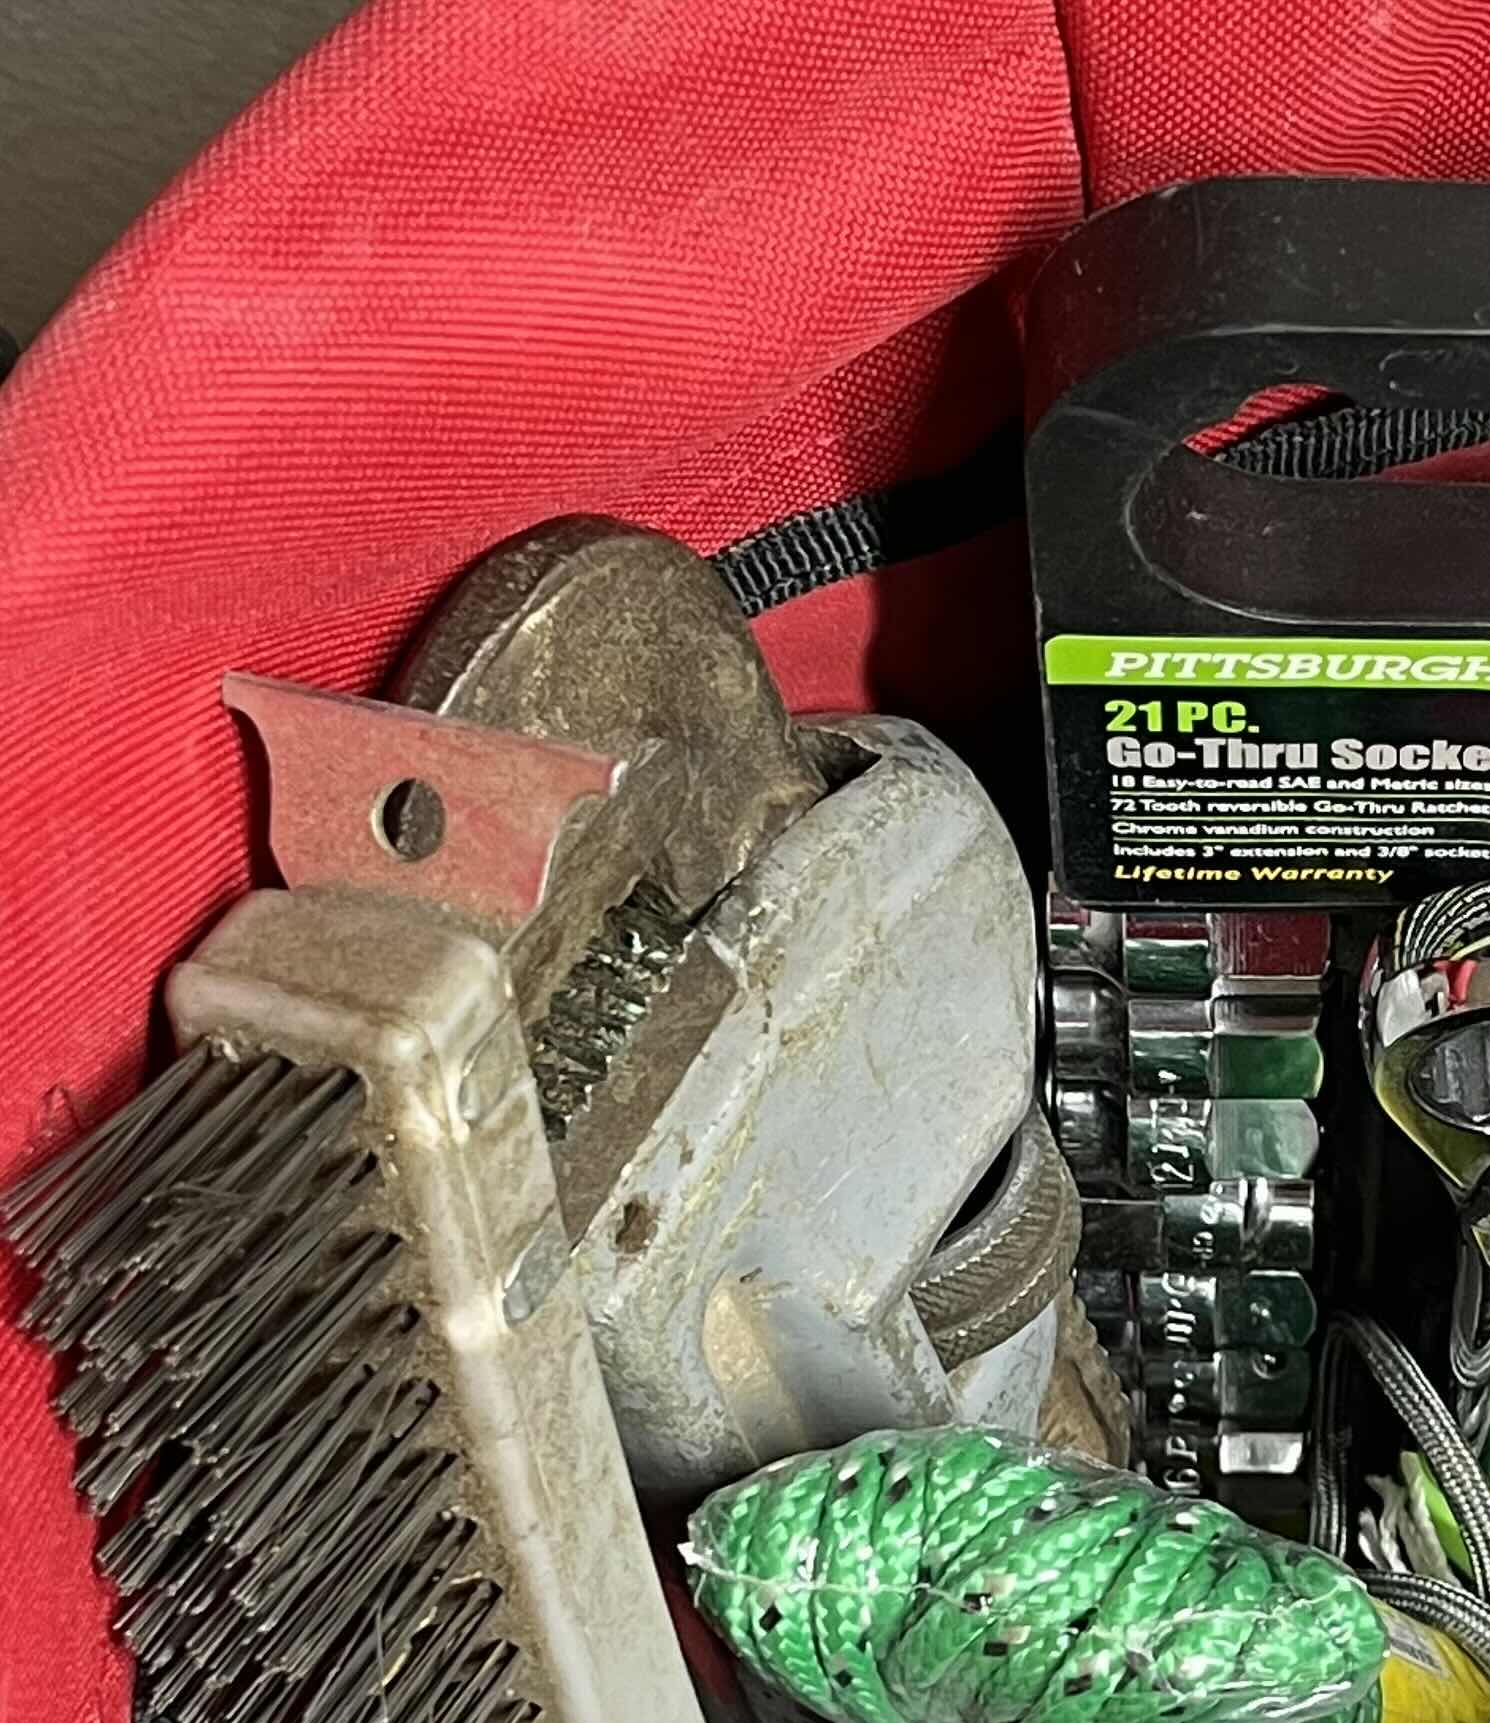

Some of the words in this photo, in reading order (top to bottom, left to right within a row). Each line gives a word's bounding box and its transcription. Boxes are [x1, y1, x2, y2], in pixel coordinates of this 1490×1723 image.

[1104, 700, 1162, 733] 21
[1177, 700, 1260, 734] PC.
[1106, 736, 1318, 769] Go-Thru
[1112, 774, 1136, 788] 18
[1143, 774, 1273, 792] Easy-to-read
[1278, 776, 1321, 789] SAE
[1326, 776, 1365, 790] and
[1371, 777, 1438, 791] Metric
[1112, 799, 1137, 812] 72
[1141, 799, 1201, 812] Tooth
[1207, 800, 1308, 813] reversible
[1313, 800, 1405, 814] Go-Thru
[1111, 821, 1198, 835] Chrome
[1202, 823, 1299, 836] vanadium
[1305, 824, 1435, 837] construction
[1113, 843, 1196, 857] Includes
[1230, 845, 1329, 857] extension
[1334, 846, 1371, 858] and
[1114, 865, 1241, 882] Lifetime
[1250, 866, 1395, 884] Warranty
